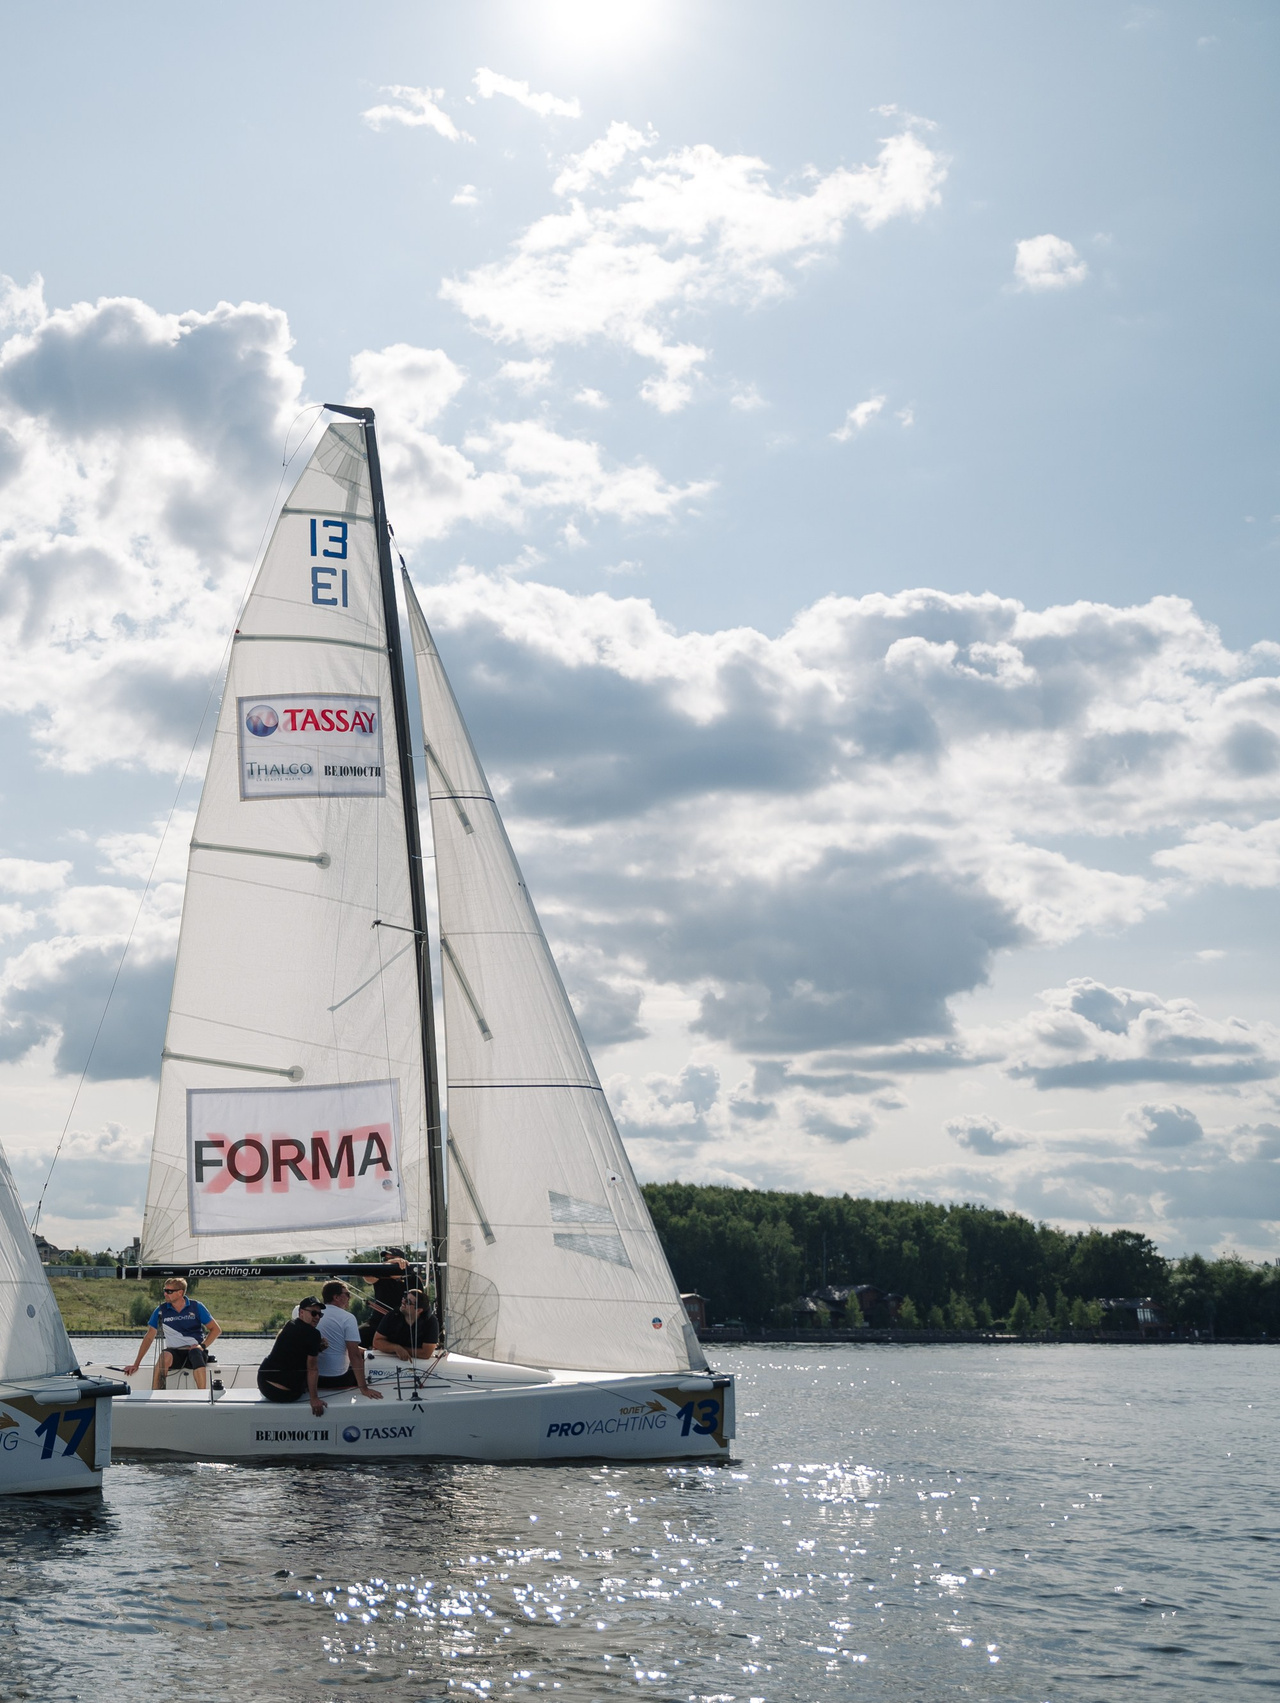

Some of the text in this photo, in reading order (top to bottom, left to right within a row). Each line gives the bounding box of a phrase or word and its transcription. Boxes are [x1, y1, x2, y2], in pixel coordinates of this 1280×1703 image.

[310, 518, 348, 560] 13
[283, 708, 376, 734] TASSAY
[324, 765, 381, 778] ВЕДОМОСТИ
[194, 1131, 393, 1184] FORMA
[188, 1266, 261, 1278] pro-yachting.ru
[546, 1413, 667, 1438] PROYACHTING
[675, 1399, 721, 1437] 13
[34, 1407, 96, 1460] 17
[255, 1430, 329, 1442] ВЕДОМОСТИ
[362, 1425, 416, 1440] TASSAY
